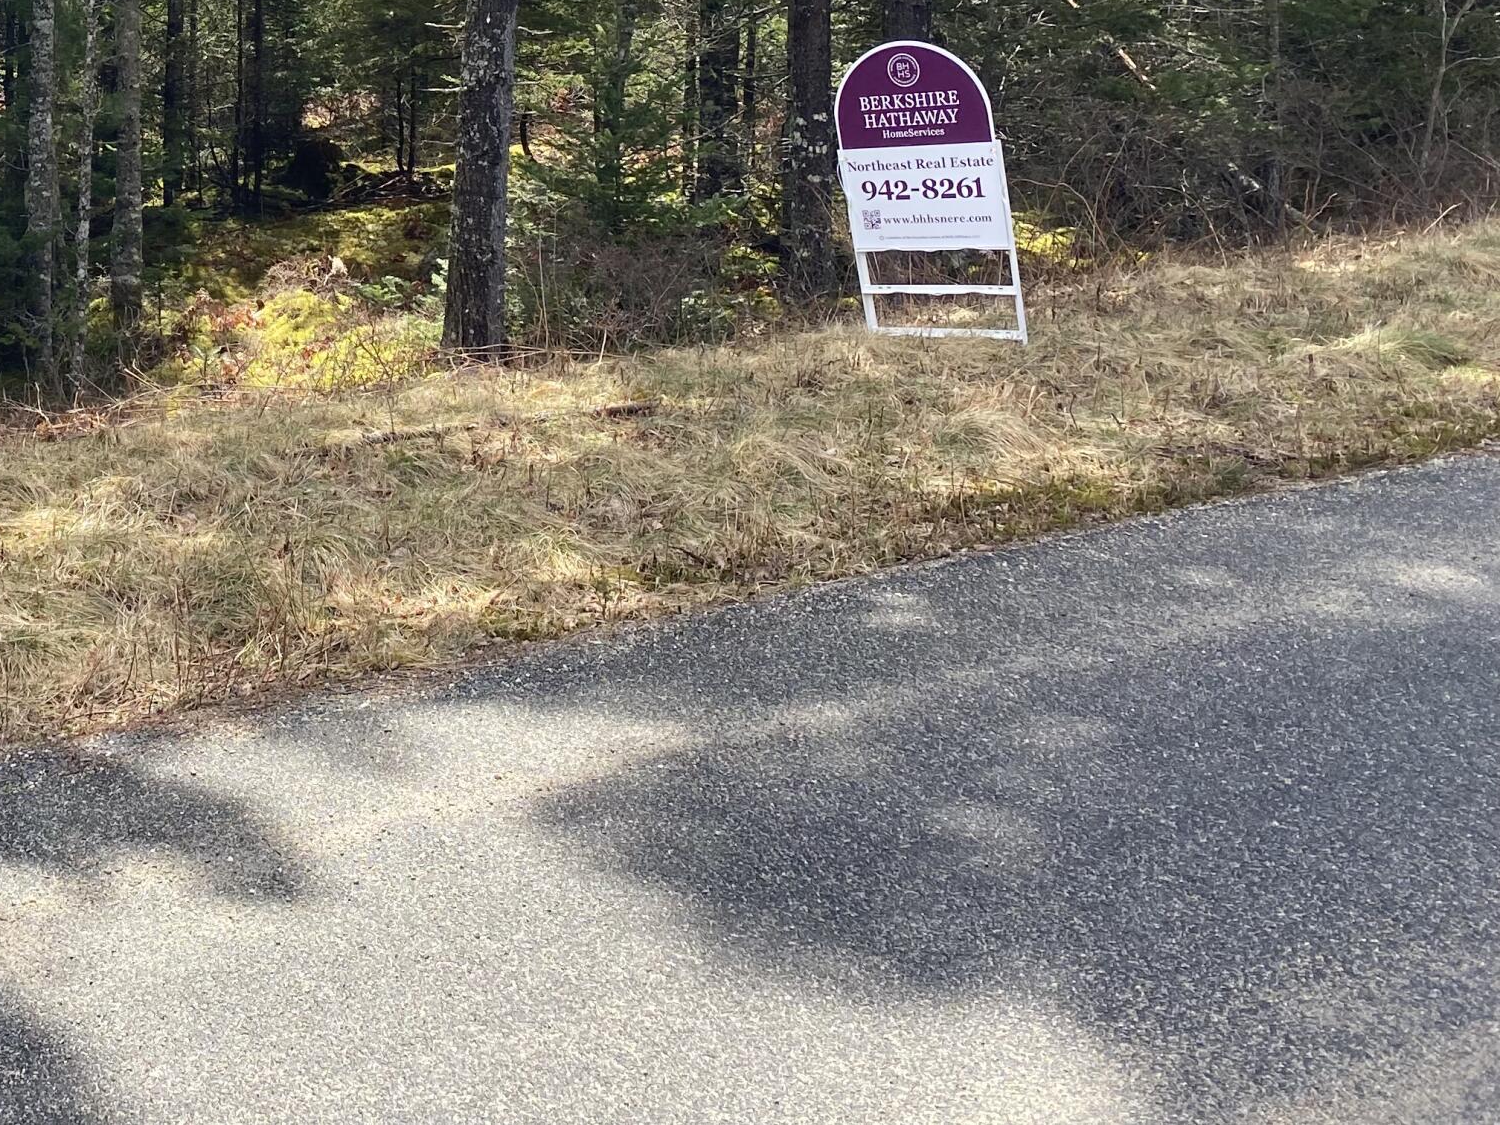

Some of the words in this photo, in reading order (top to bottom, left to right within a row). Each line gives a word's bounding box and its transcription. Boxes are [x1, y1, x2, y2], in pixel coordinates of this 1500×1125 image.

[859, 90, 960, 112] BERKSHIRE
[864, 108, 959, 129] HATHAWAY
[883, 128, 945, 139] HomeServices
[847, 159, 911, 172] Northeast
[915, 156, 946, 170] Real
[950, 156, 994, 168] Estate
[861, 176, 986, 201] 942-8261
[883, 213, 992, 225] www.bhhsnere.com
